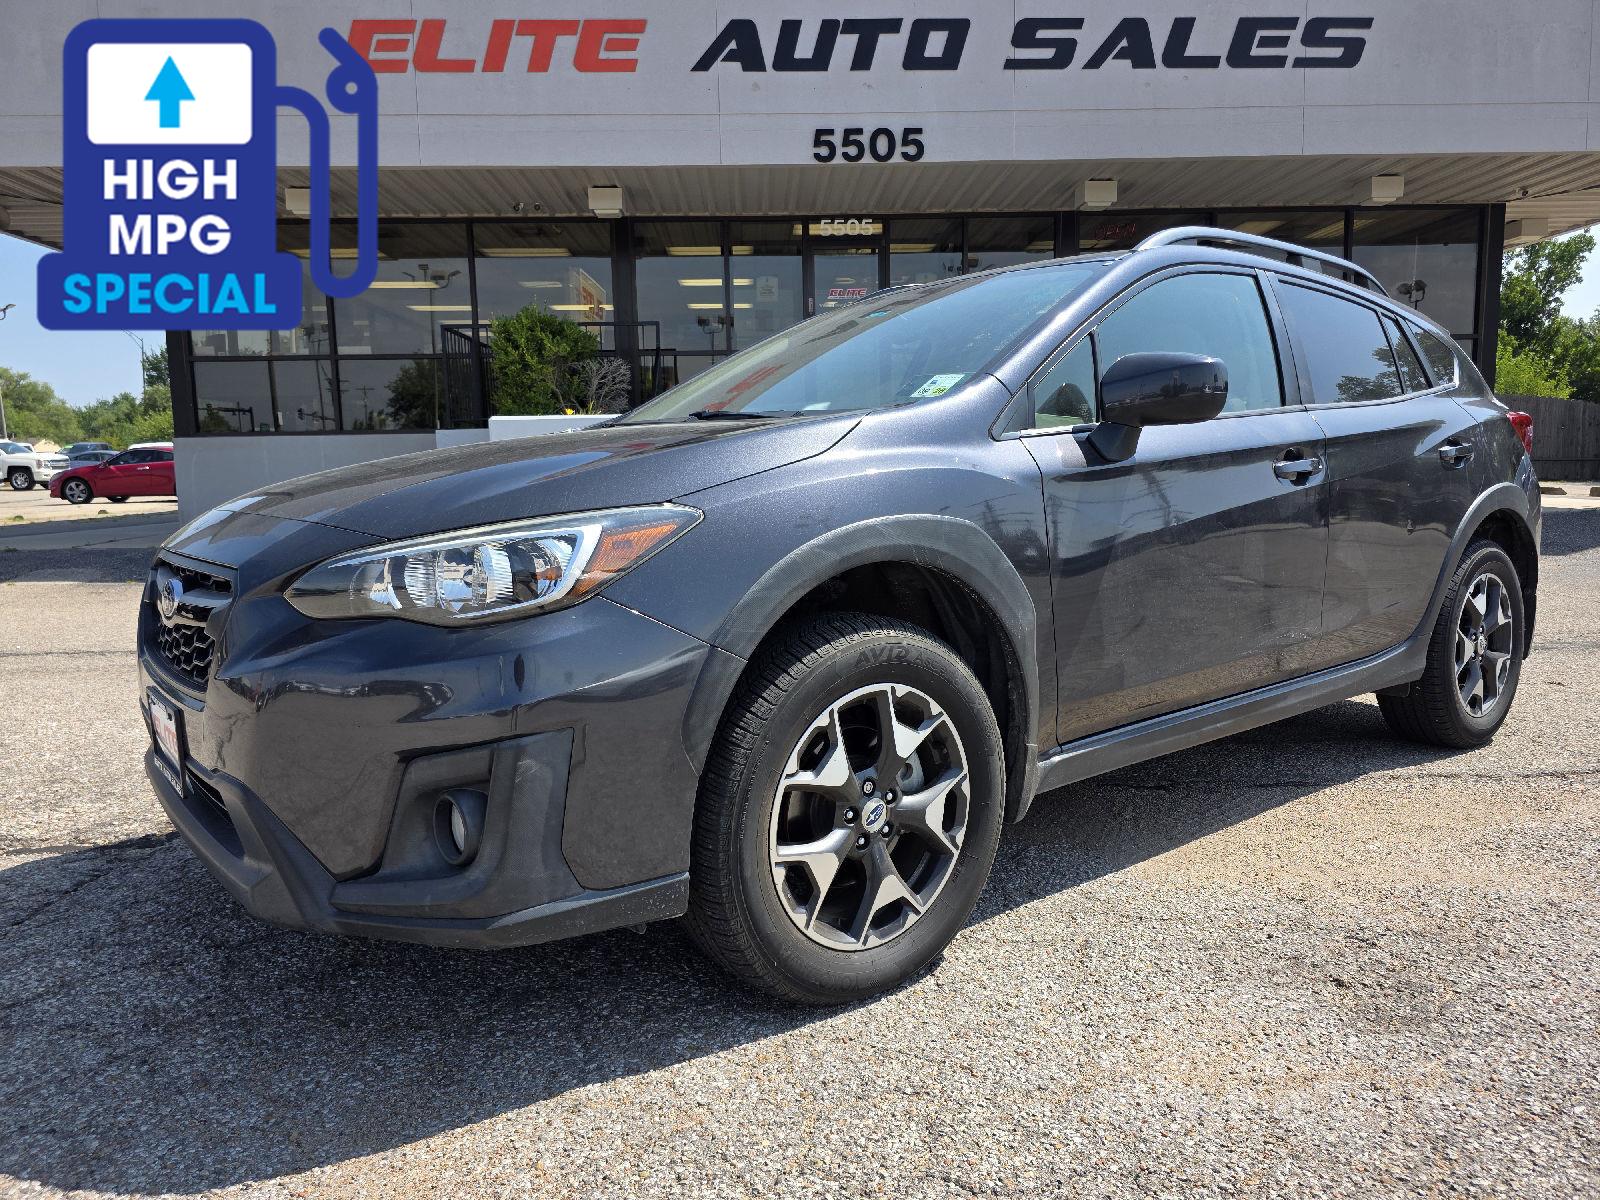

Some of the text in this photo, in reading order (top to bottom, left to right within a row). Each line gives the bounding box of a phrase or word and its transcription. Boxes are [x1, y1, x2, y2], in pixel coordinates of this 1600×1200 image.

[347, 17, 1374, 73] ELITE AUTO SALES
[813, 127, 925, 164] 5505
[820, 218, 875, 236] 5505
[827, 287, 868, 299] ELITE
[855, 645, 911, 666] AVID
